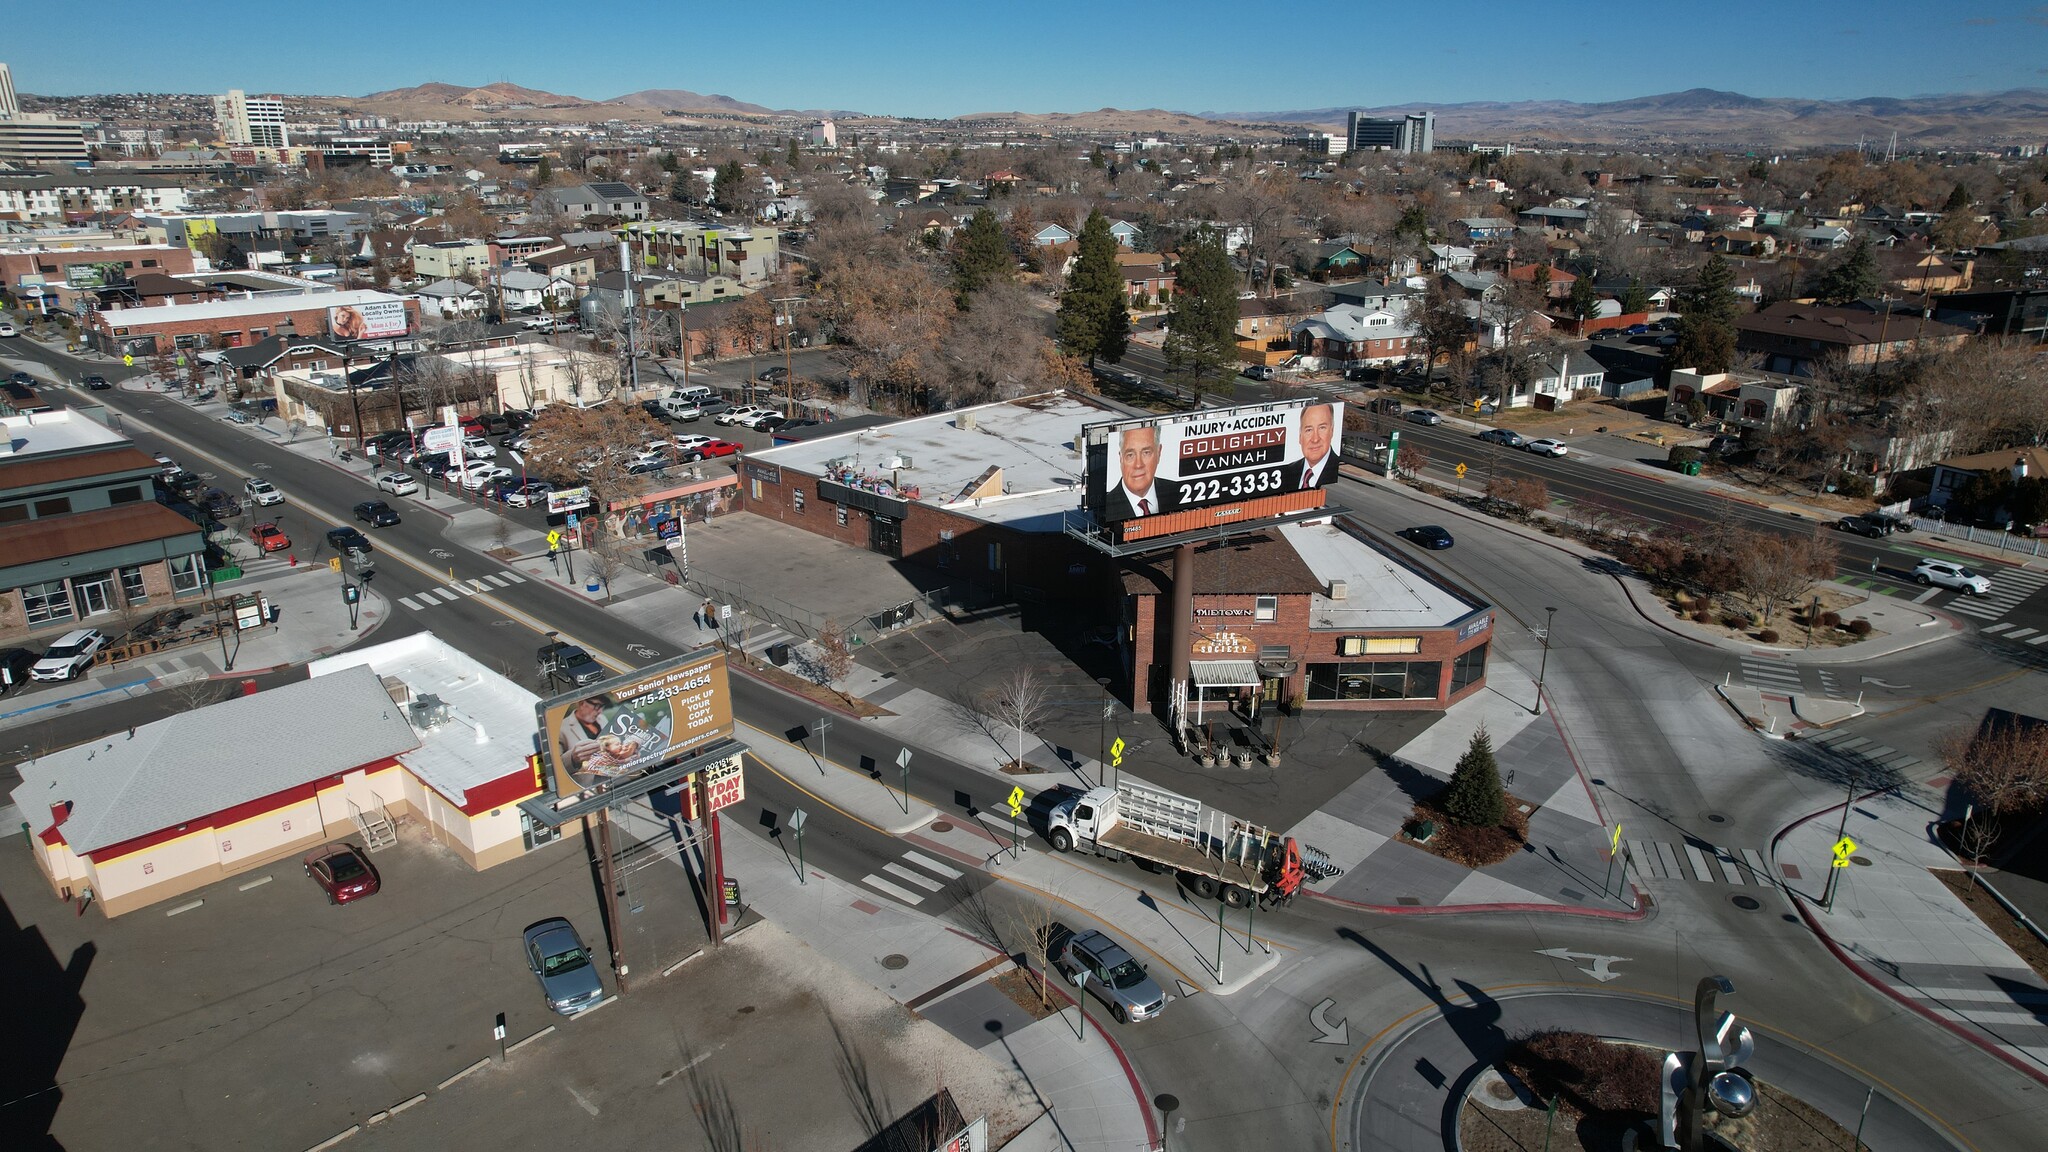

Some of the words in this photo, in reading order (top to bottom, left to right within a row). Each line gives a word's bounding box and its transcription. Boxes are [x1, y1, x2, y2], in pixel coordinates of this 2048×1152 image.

[1184, 421, 1226, 437] INJURY
[1233, 414, 1286, 430] ACCIDENT
[1182, 430, 1285, 456] GOLIGHTLY
[1195, 450, 1267, 470] VANNAH
[1178, 470, 1283, 504] 222-3333
[1196, 609, 1254, 617] MIDTOWN
[1215, 632, 1236, 640] THE
[616, 687, 637, 700] Your
[637, 679, 665, 695] Senior
[666, 663, 712, 683] Newspaper
[631, 674, 712, 709] 775-233-4654
[681, 693, 702, 706] PICK
[702, 689, 714, 700] UP
[687, 699, 711, 713] YOUR
[687, 715, 714, 729] TODAY
[688, 707, 711, 721] COPY
[618, 728, 719, 771] seniorspectrumnewspapers.com
